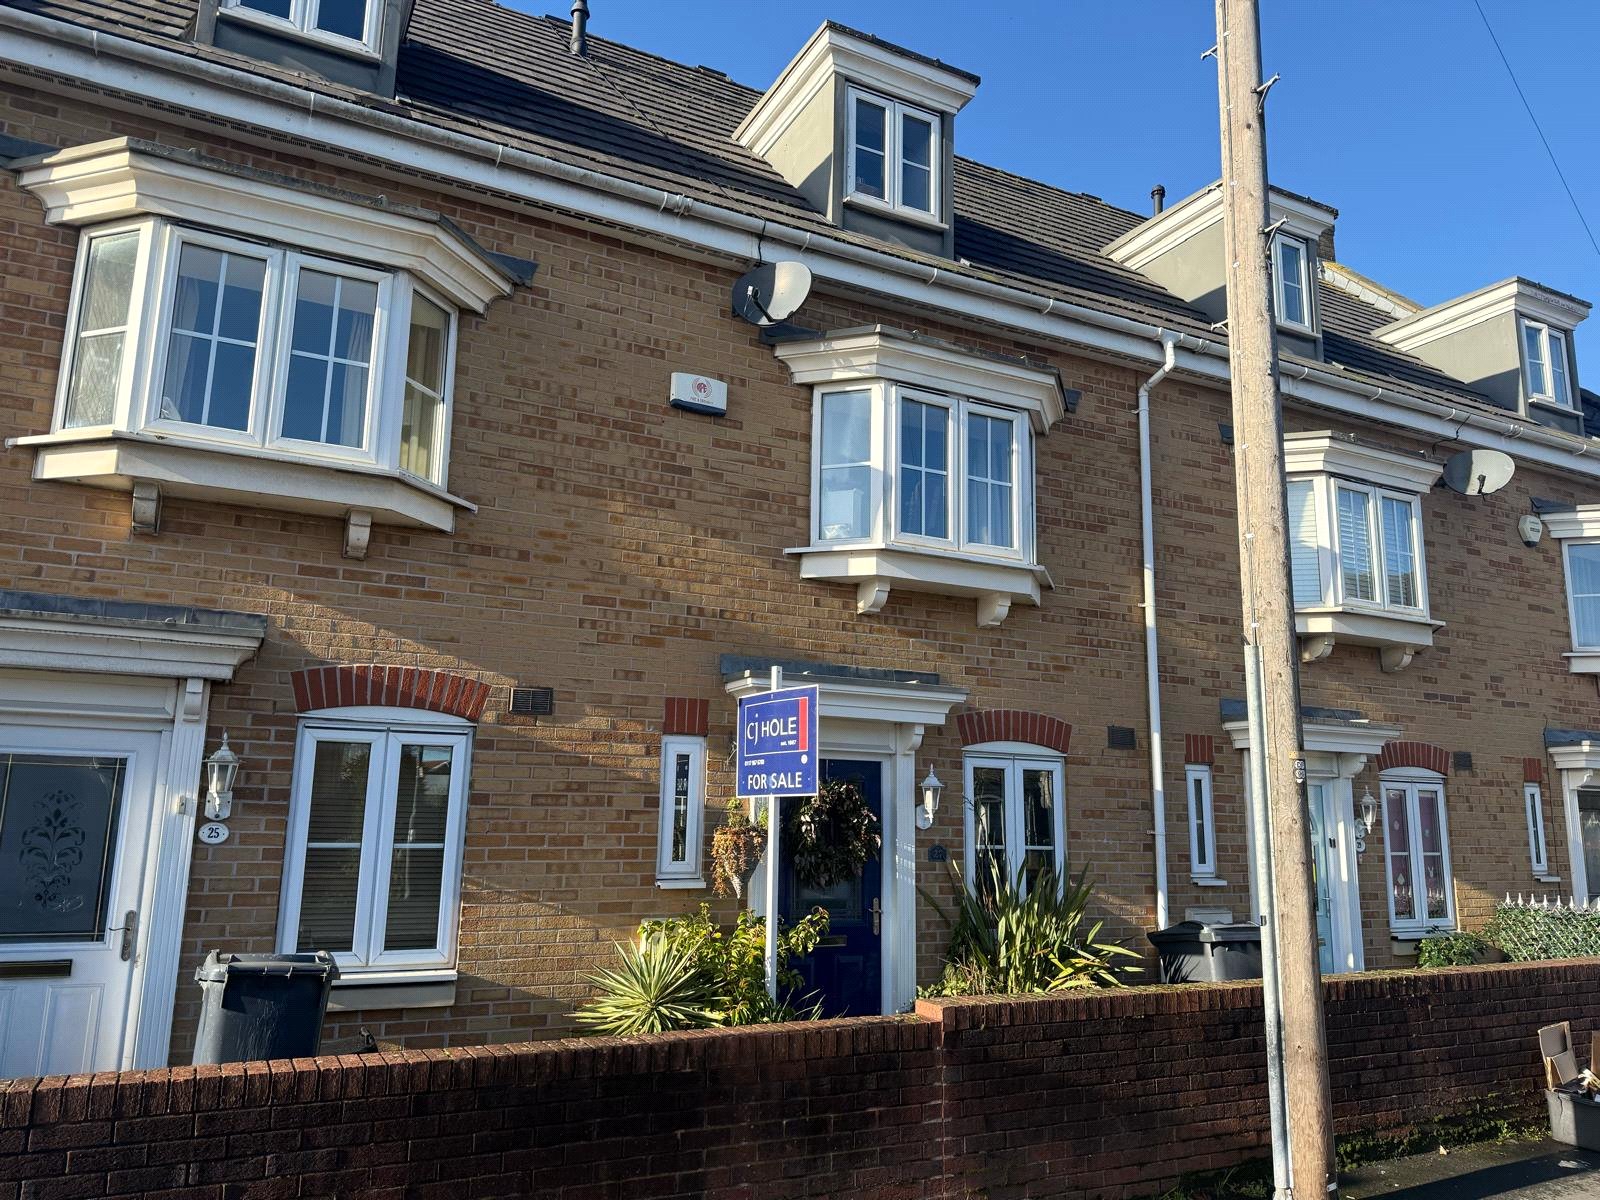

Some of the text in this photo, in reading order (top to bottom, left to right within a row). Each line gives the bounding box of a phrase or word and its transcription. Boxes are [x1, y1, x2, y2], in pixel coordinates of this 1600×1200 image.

[762, 717, 797, 738] HOLE
[748, 772, 803, 790] FOR SALE
[207, 827, 220, 838] 25
